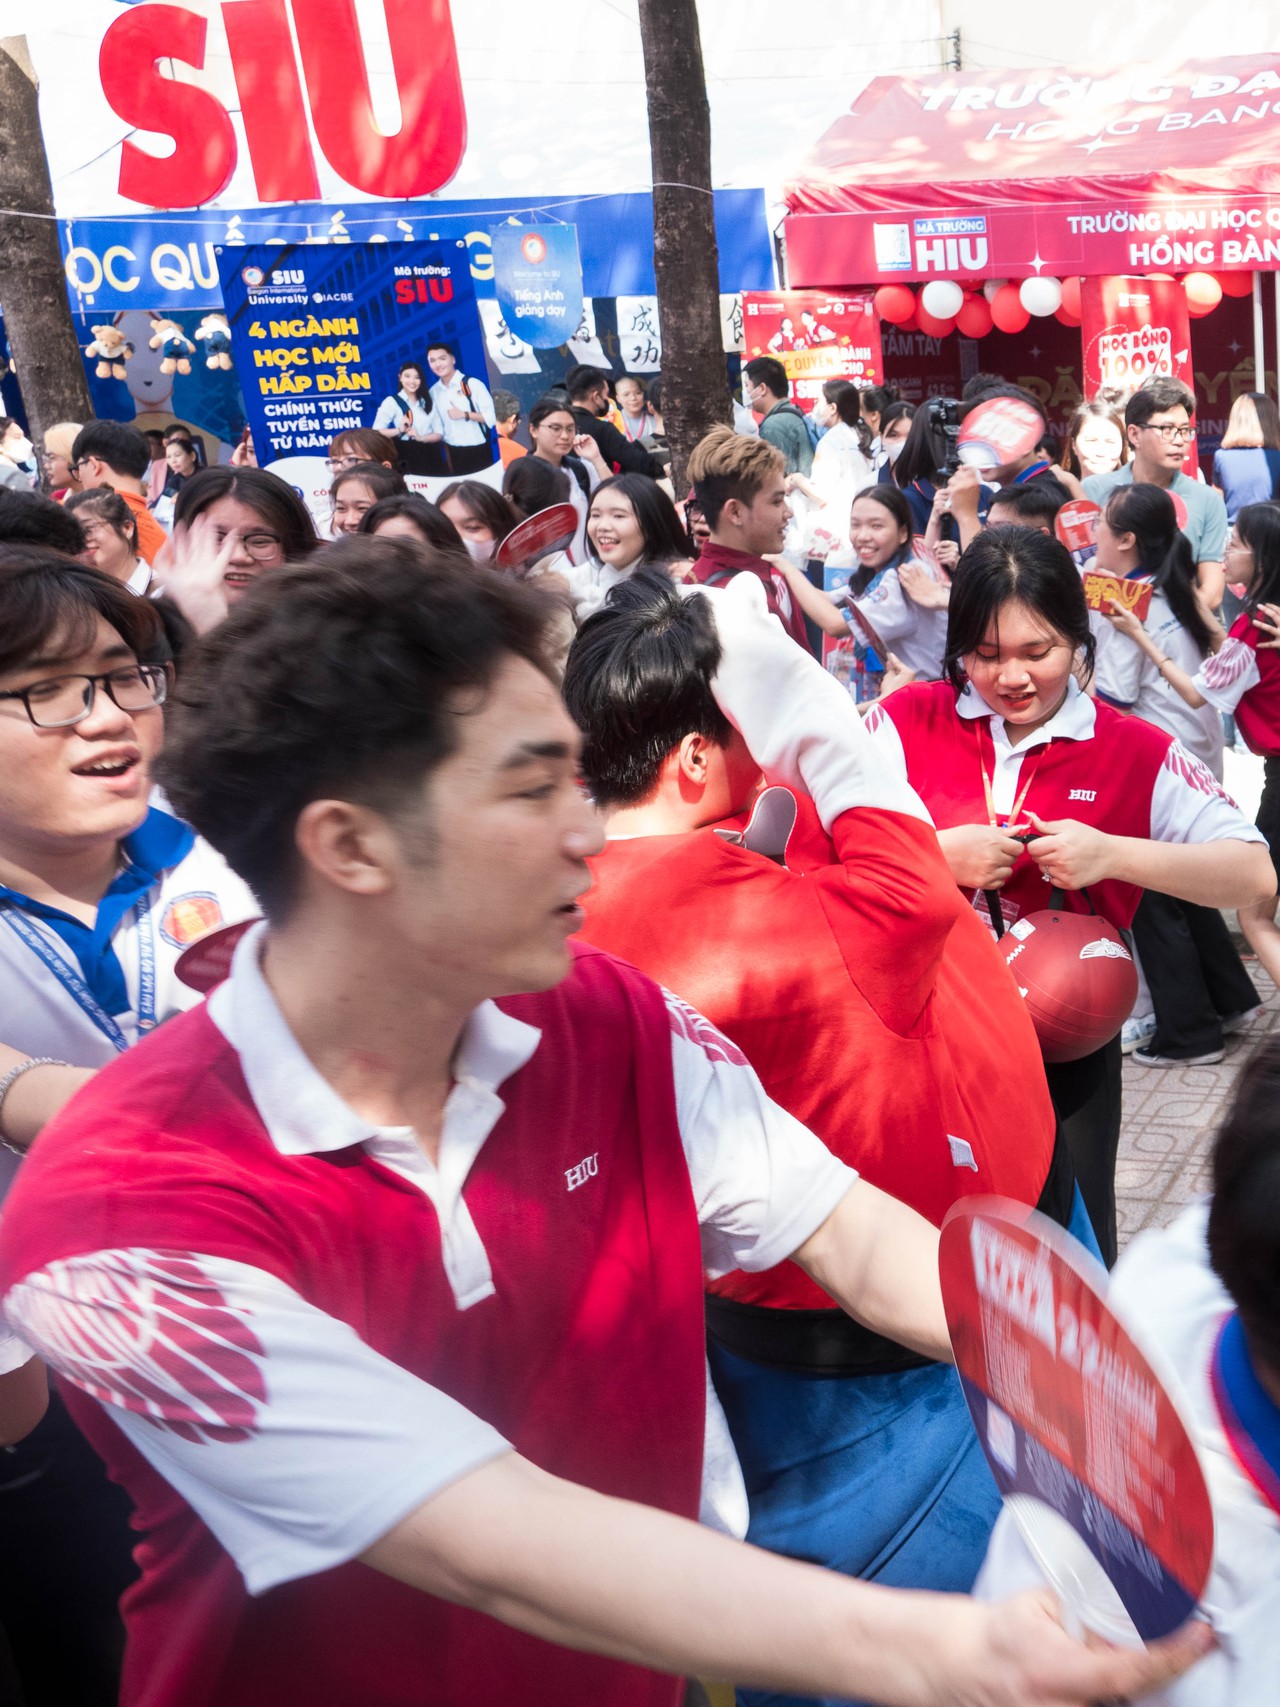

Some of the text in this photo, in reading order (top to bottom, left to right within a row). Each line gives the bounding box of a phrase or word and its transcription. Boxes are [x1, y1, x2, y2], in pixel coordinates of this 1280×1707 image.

[919, 73, 1174, 112] TRƯỜNG
[99, 0, 468, 209] SIU
[1067, 207, 1161, 235] TRƯỜNG
[1164, 208, 1206, 233] ĐẠI
[1211, 207, 1262, 233] HỌC
[916, 237, 989, 272] HIU
[1130, 235, 1214, 267] HỒNG
[272, 269, 305, 285] SIU
[394, 265, 413, 277] Mã
[248, 293, 309, 306] University
[395, 277, 454, 304] SIU
[514, 288, 564, 303] Tiếng Anh
[515, 303, 566, 318] giảng dạy
[249, 314, 359, 339] 4 NGÀNH
[253, 341, 361, 371] HỌC MỚI
[841, 362, 864, 375] CHO
[259, 365, 371, 395] HẤP DẪN
[264, 399, 364, 417] CHÍNH THỨC
[323, 416, 362, 430] SINH
[270, 431, 333, 450] TỪ NĂM
[412, 482, 428, 490] TIN
[1068, 789, 1097, 802] HIU
[564, 1152, 599, 1191] HIU
